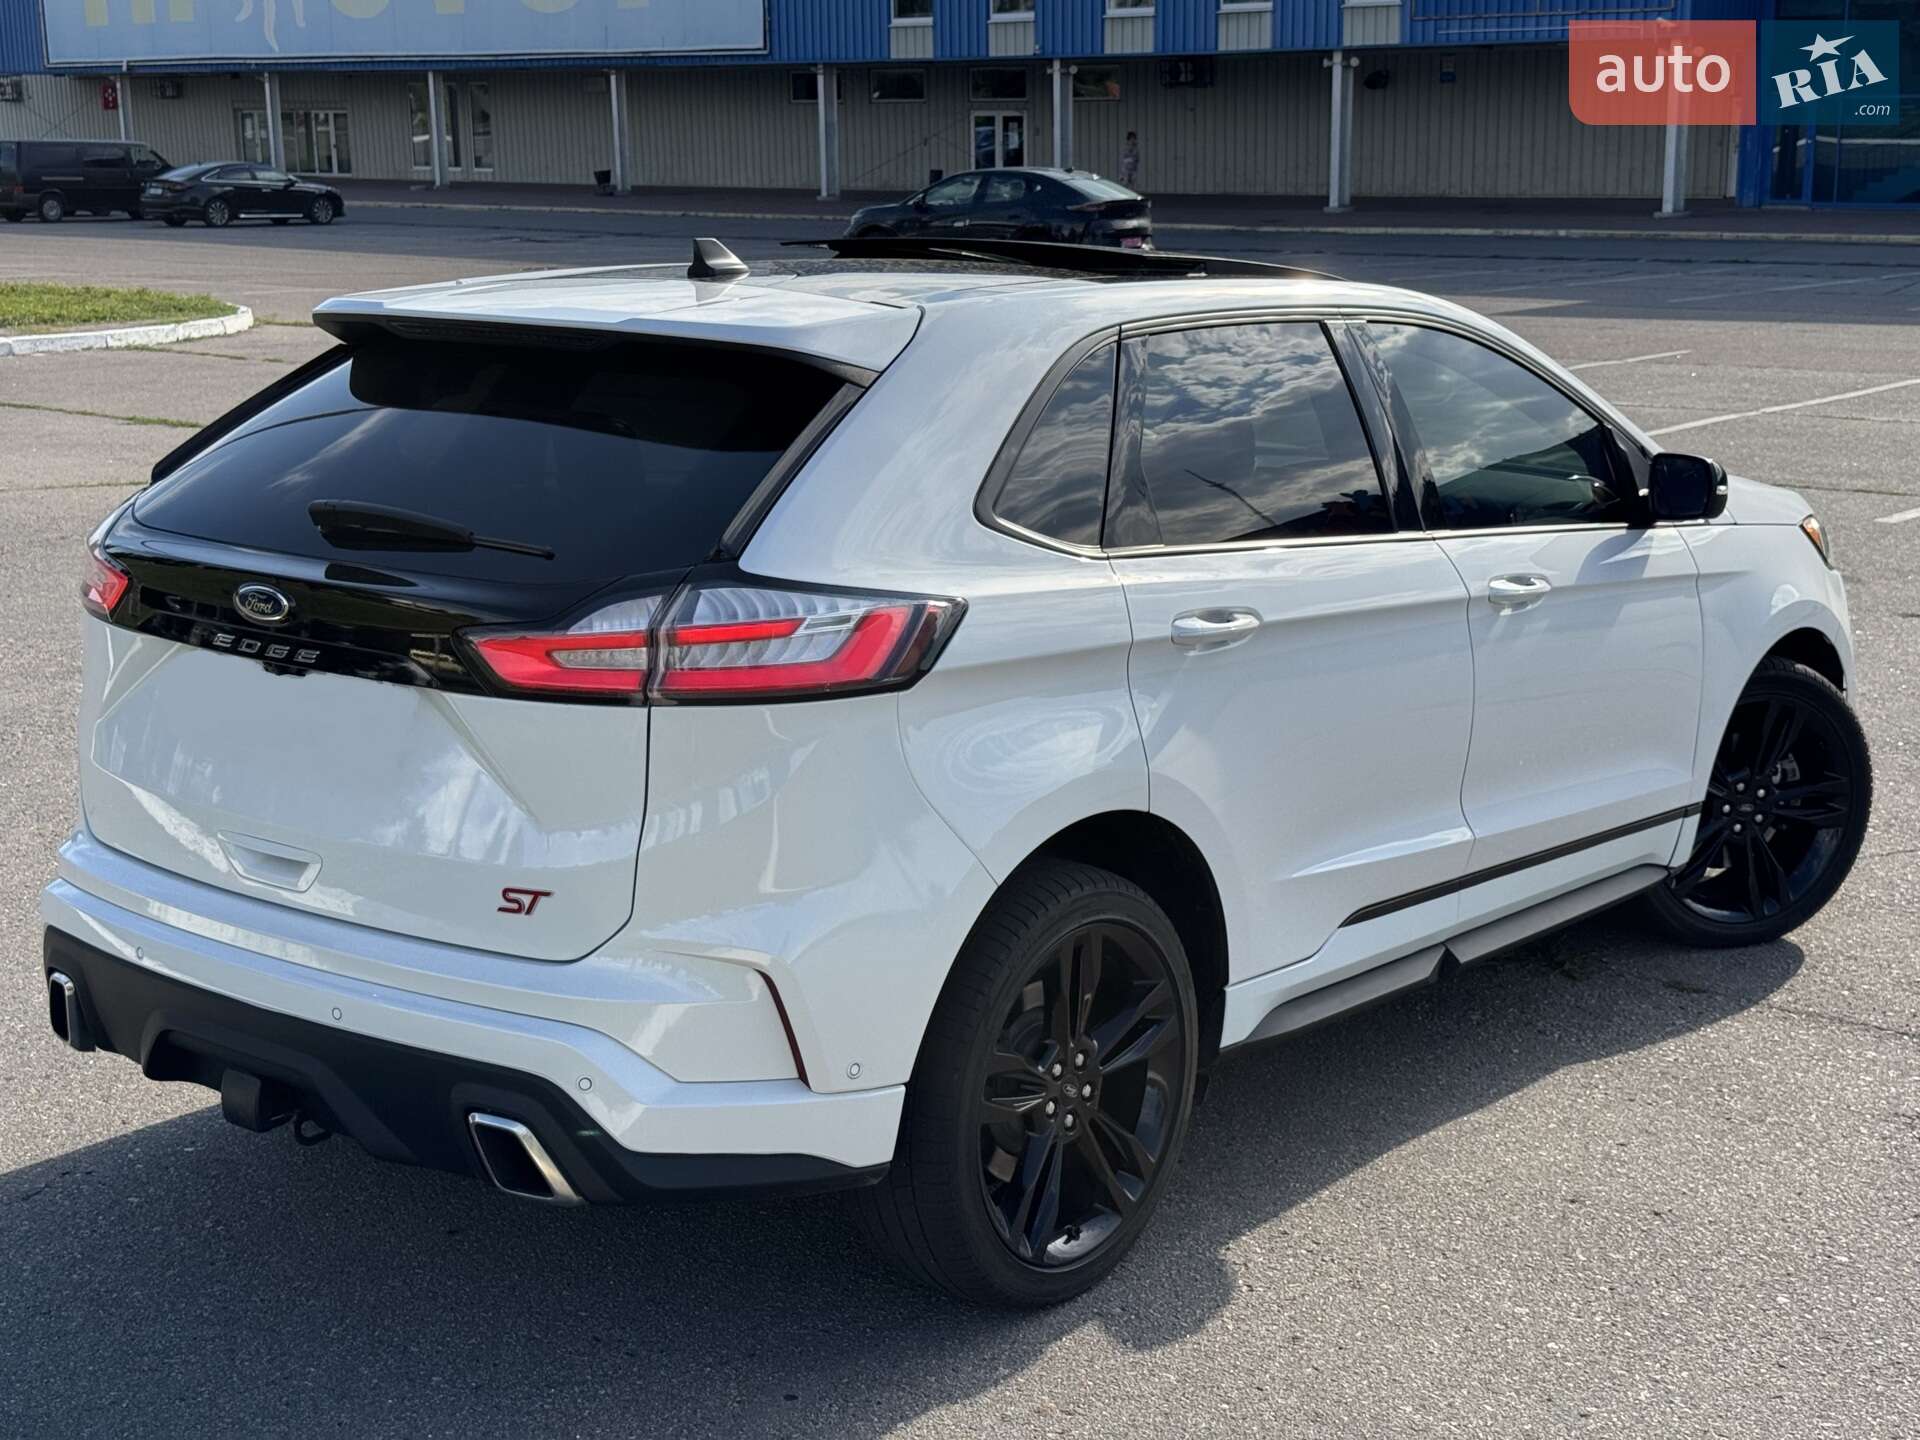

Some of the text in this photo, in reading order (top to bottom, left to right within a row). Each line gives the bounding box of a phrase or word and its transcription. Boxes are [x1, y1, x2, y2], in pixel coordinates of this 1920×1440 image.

[244, 592, 275, 614] Ford
[212, 633, 320, 663] EDGE
[497, 887, 554, 915] ST
